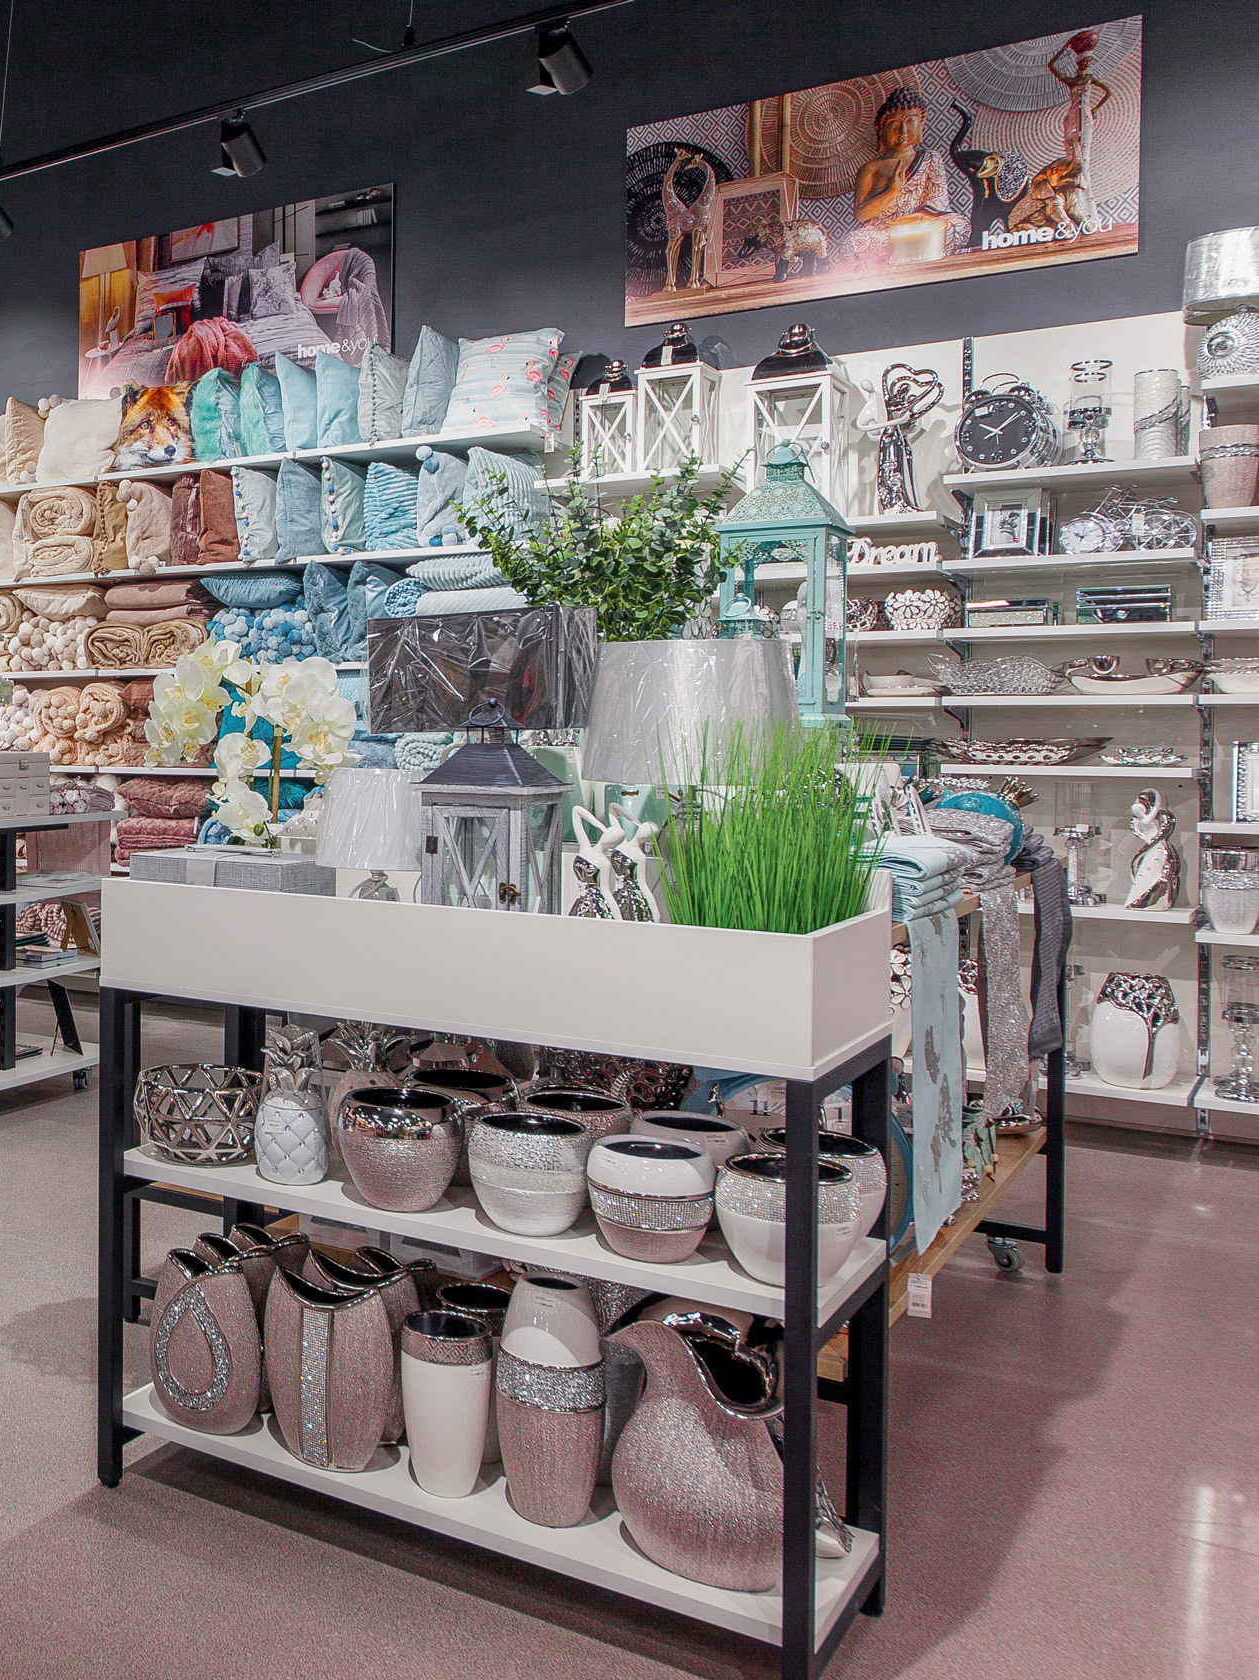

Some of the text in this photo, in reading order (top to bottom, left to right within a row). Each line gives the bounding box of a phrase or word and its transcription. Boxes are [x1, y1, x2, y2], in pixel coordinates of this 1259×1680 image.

[981, 217, 1113, 250] home&you
[847, 536, 942, 565] Dream
[750, 1099, 771, 1116] 11
